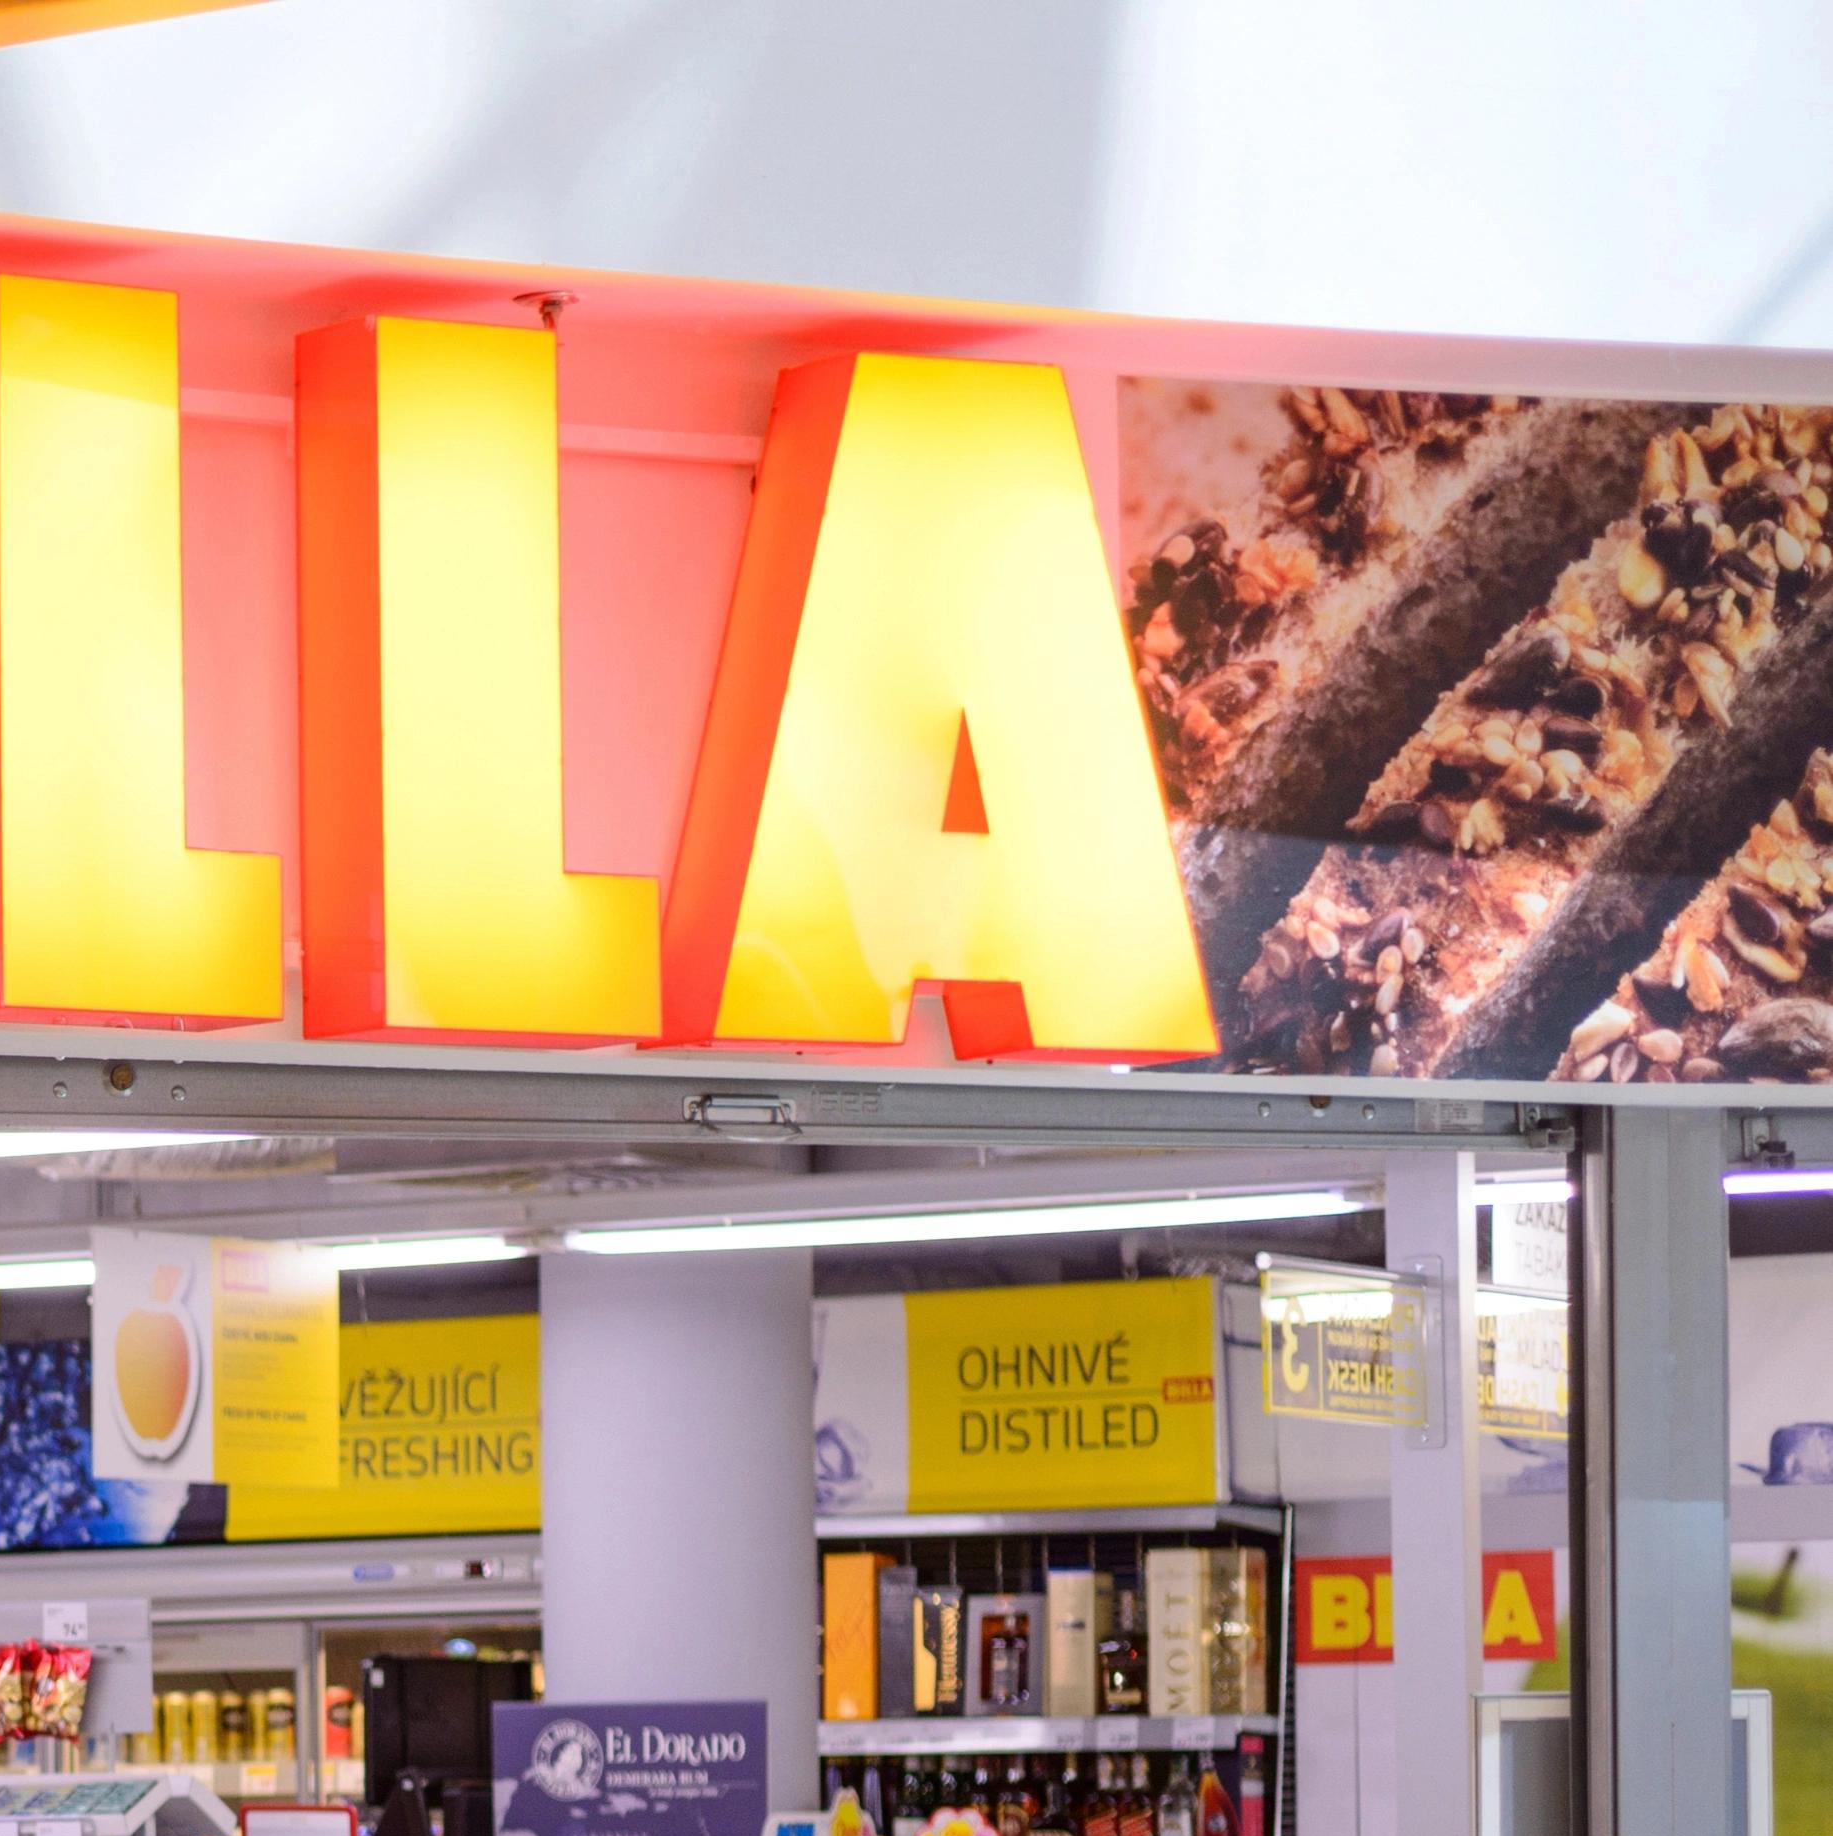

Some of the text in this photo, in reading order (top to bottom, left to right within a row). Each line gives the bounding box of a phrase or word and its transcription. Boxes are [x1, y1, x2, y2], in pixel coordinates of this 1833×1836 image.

[958, 1334, 1131, 1392] OHNIVÉ
[960, 1402, 1160, 1458] DISTILED
[605, 1726, 637, 1765] EL
[642, 1725, 747, 1767] DORADO
